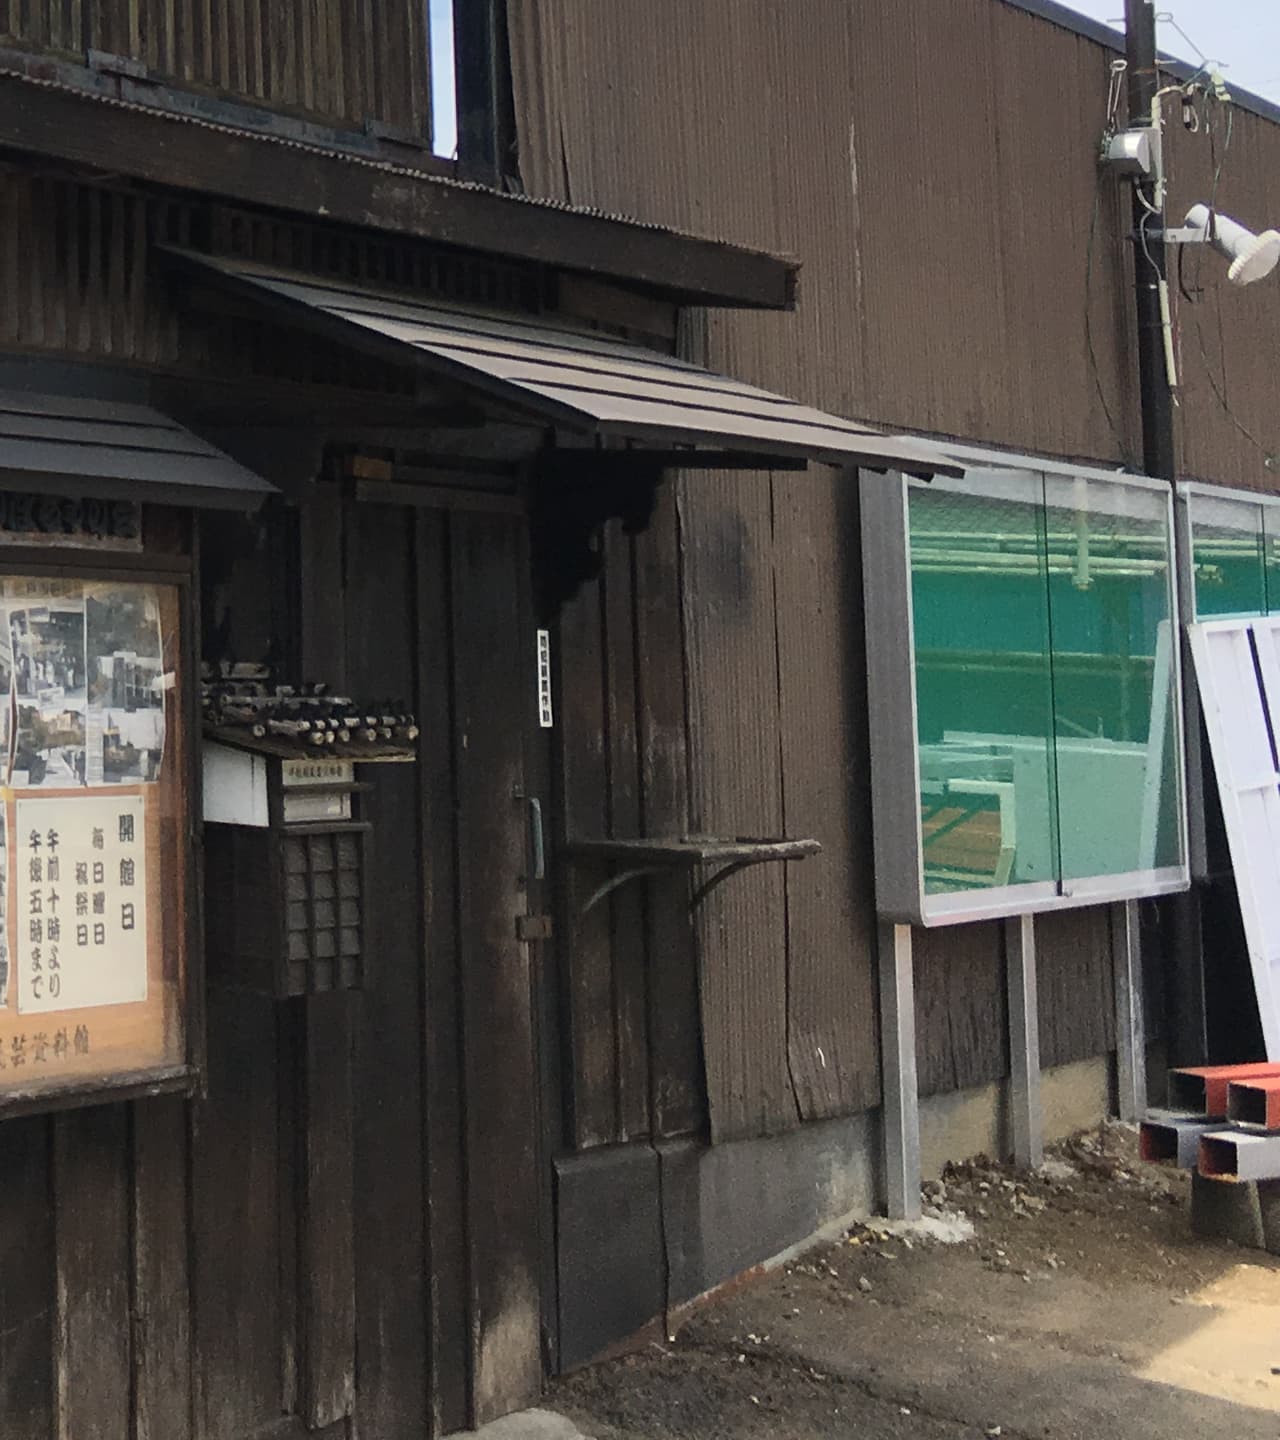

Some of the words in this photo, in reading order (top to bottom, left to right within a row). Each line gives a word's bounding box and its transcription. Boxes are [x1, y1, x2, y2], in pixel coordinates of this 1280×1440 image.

[29, 829, 43, 999] 午後五時まで
[47, 828, 61, 998] 午前十時より
[118, 813, 136, 931] 開館日
